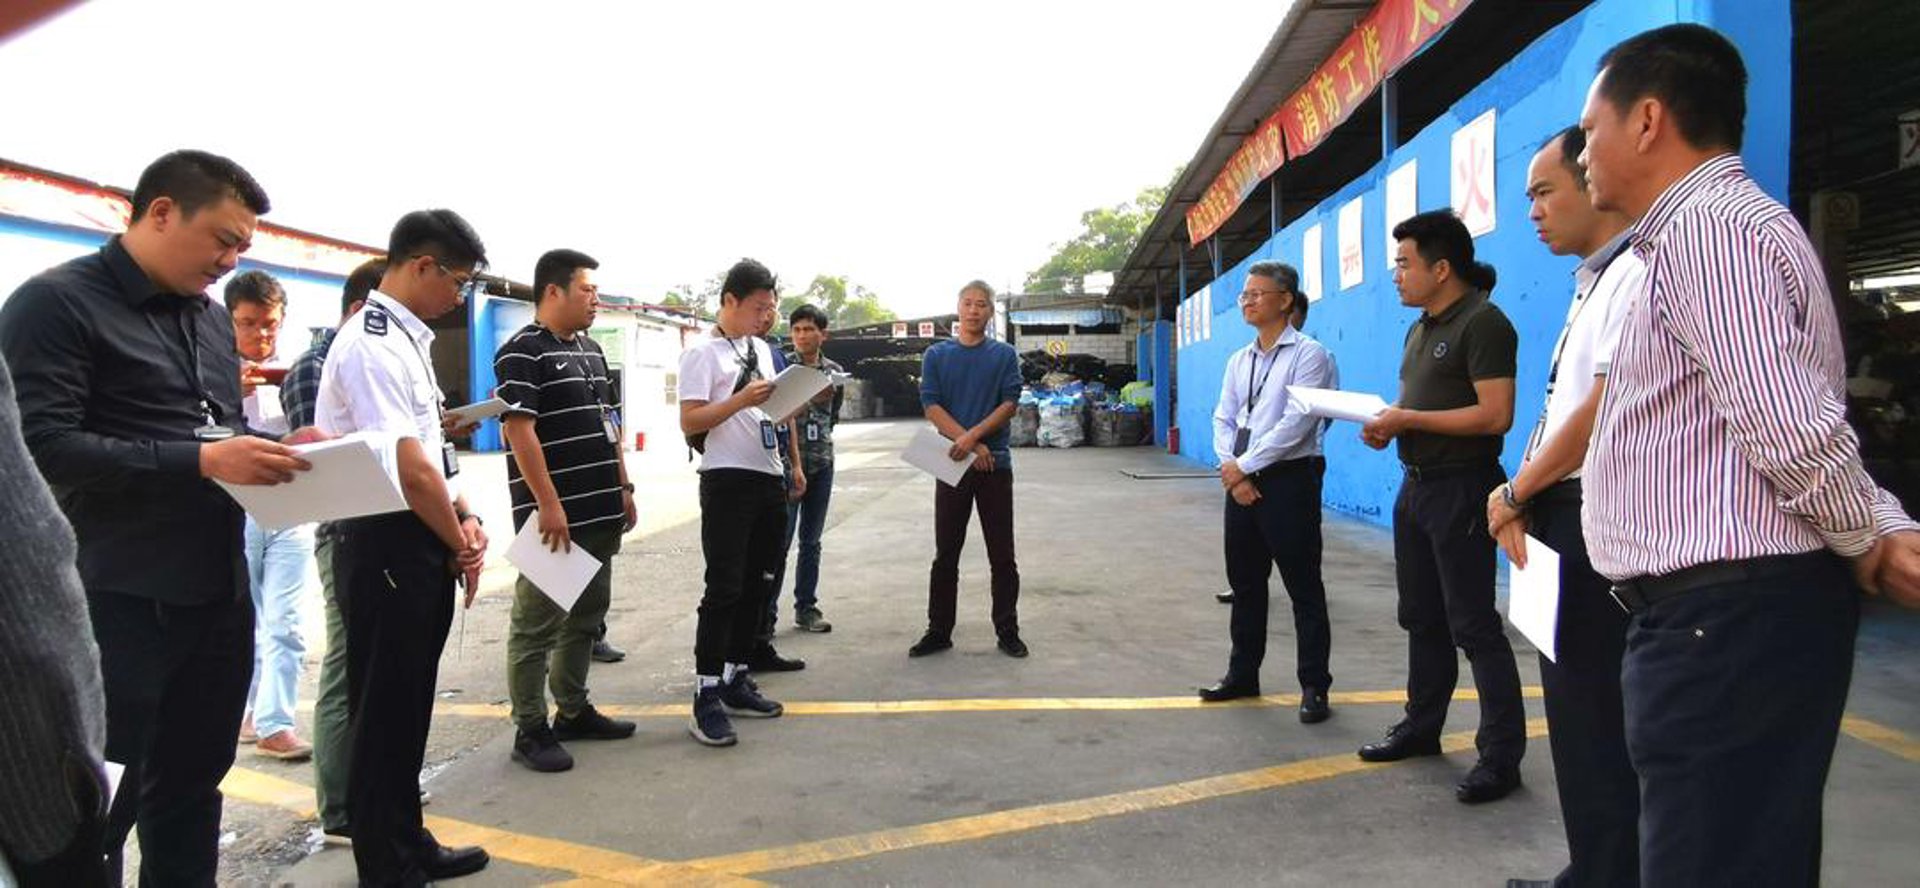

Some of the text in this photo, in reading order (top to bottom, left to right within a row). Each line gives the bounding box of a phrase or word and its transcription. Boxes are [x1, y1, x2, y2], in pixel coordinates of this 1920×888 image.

[1297, 25, 1384, 145] 消防工作
[1458, 138, 1490, 219] 火
